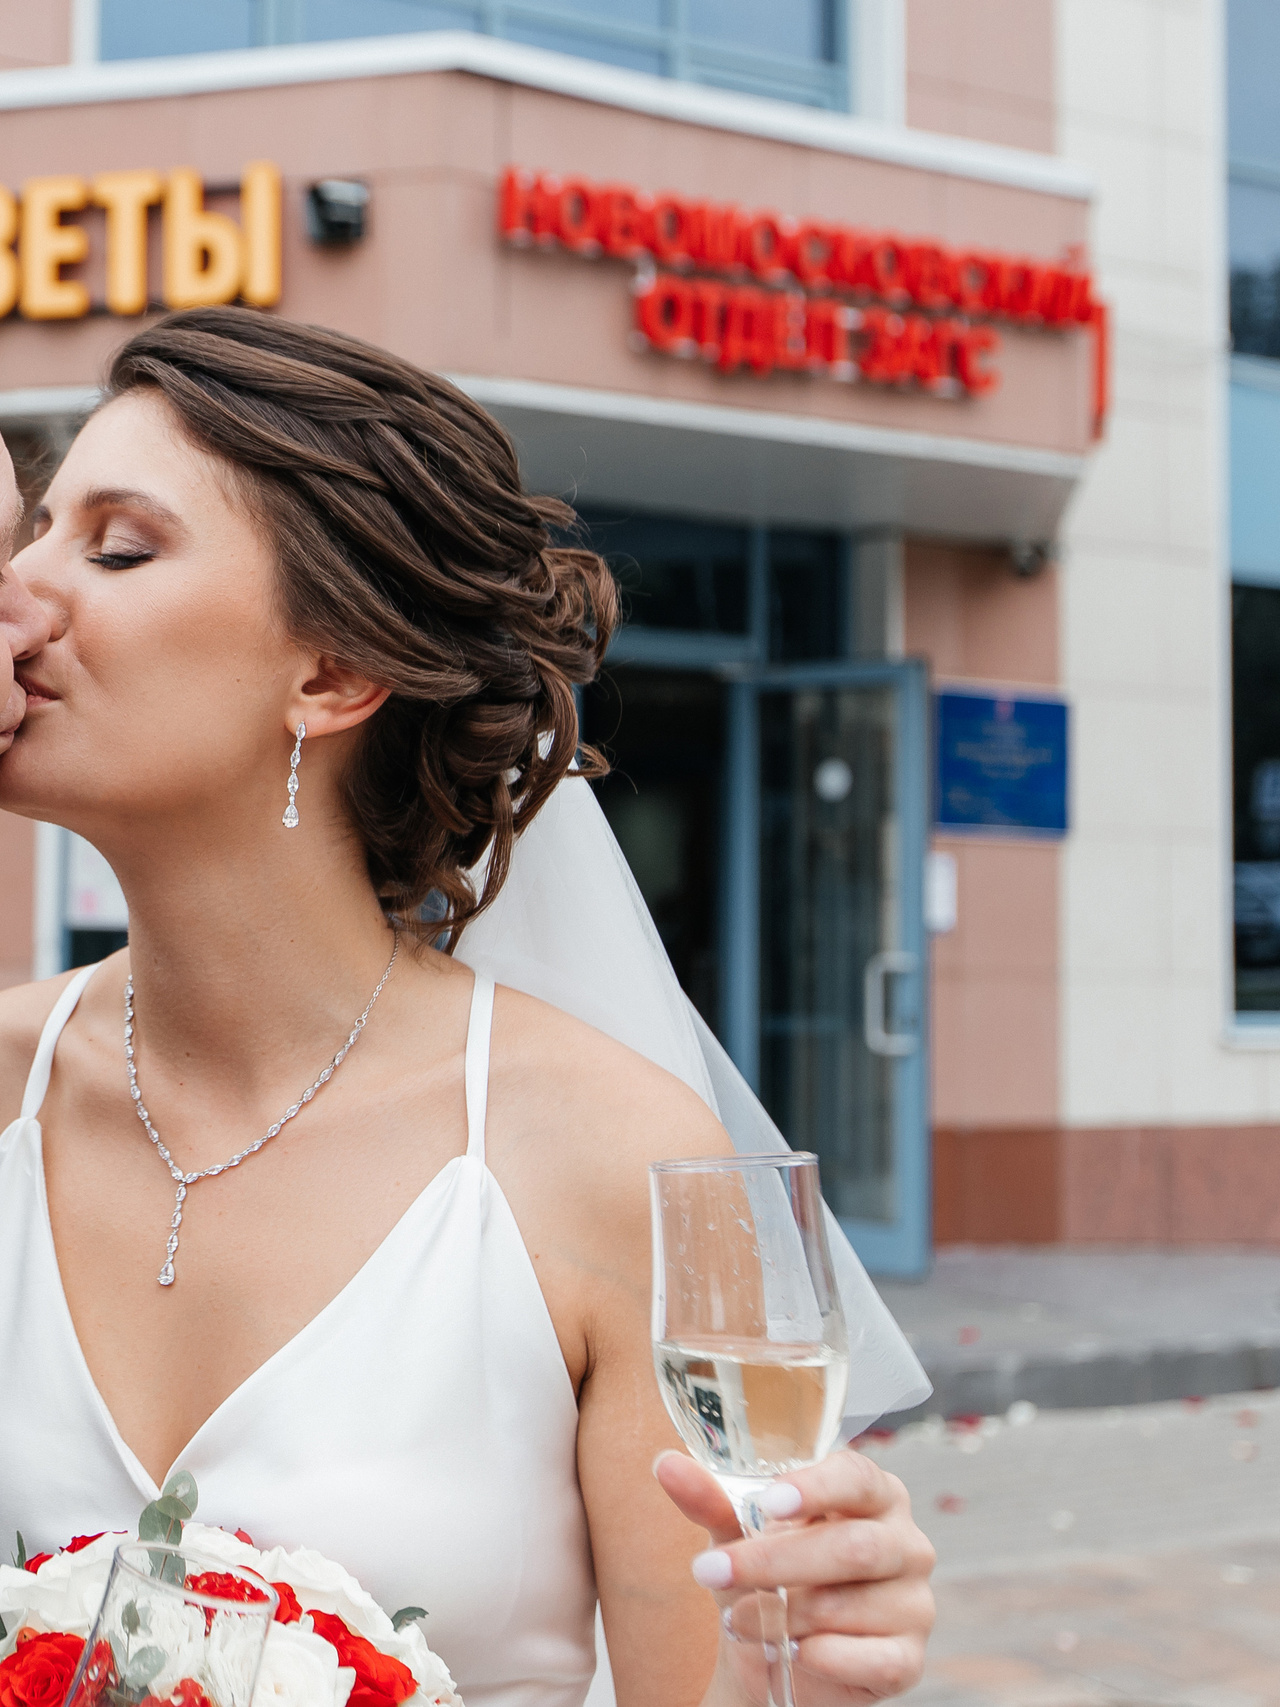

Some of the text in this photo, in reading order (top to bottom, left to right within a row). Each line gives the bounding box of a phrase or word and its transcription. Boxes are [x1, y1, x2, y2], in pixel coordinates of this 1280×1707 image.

[498, 168, 1092, 330] НОВОМОСКОВСКИЙ
[636, 276, 1003, 398] ОТДЕЛ ЗАГС
